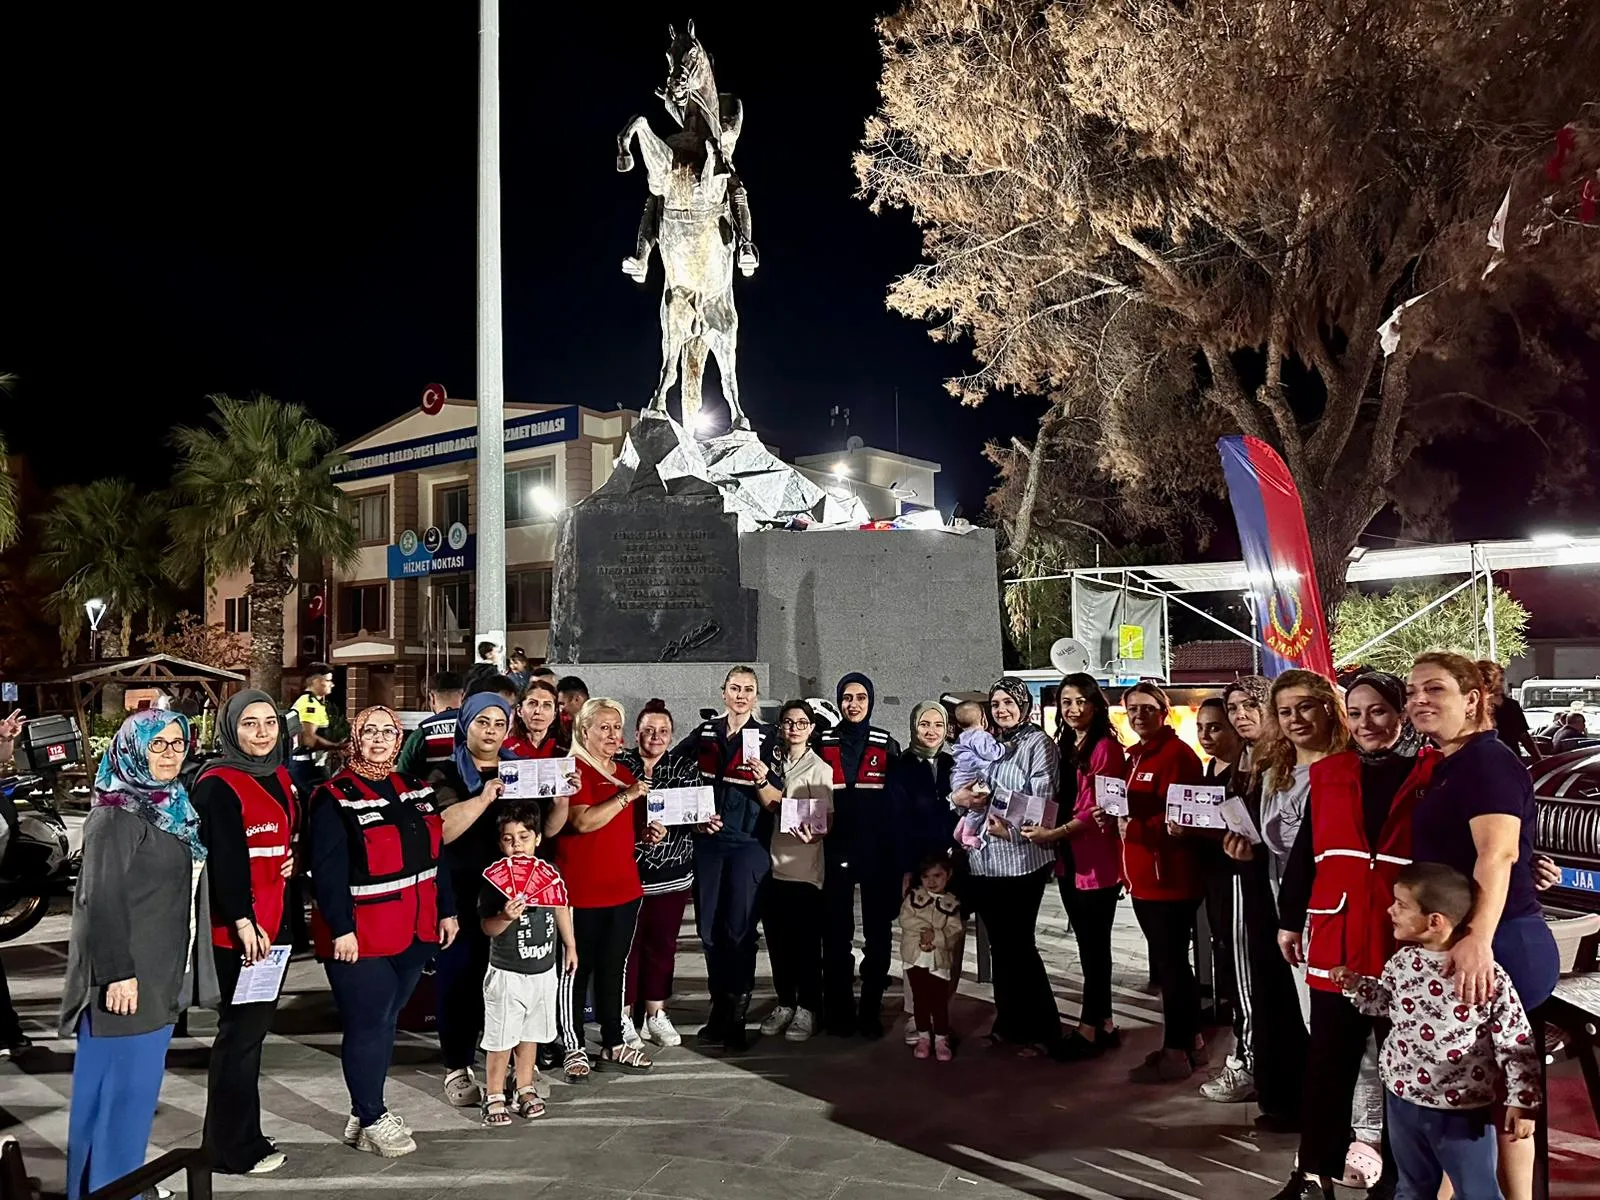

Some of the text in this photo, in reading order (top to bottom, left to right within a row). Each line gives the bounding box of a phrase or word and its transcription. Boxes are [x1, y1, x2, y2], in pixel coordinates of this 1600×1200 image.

[504, 425, 530, 441] ZMET
[531, 417, 565, 437] BİNASI
[403, 556, 464, 573] HİZMET NOKTASI
[50, 745, 63, 755] 112
[518, 941, 554, 960] BOOM
